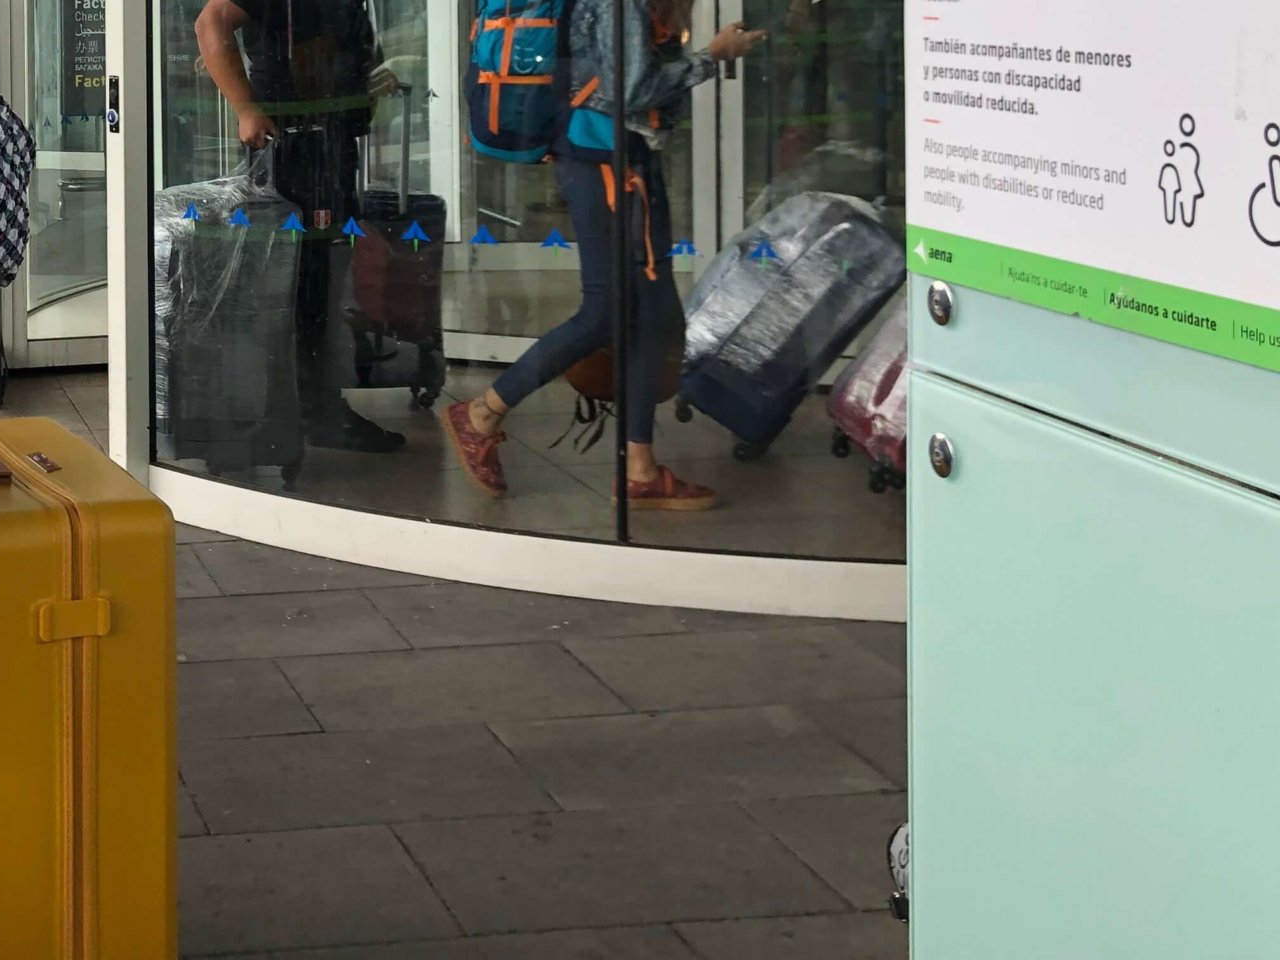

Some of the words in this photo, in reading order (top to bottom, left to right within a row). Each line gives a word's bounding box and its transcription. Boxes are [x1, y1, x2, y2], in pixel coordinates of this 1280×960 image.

[923, 36, 967, 56] También
[970, 42, 1052, 64] acompañantes
[1055, 46, 1071, 63] de
[1074, 51, 1132, 68] menores
[923, 66, 930, 80] y
[932, 66, 979, 82] personas
[982, 71, 1001, 85] con
[1004, 70, 1081, 92] discapacidad
[923, 90, 930, 102] o
[932, 90, 983, 109] movilidad
[986, 95, 1039, 115] reducida.
[923, 137, 944, 155] Also
[946, 141, 979, 162] people
[981, 148, 1058, 177] accompanying
[1060, 159, 1101, 181] minors
[1103, 167, 1127, 185] and
[923, 164, 956, 184] people
[958, 169, 980, 187] with
[982, 173, 1039, 198] disabilities
[1041, 186, 1054, 200] or
[1056, 187, 1104, 210] reduced
[923, 188, 965, 212] mobility.
[928, 247, 952, 263] aena
[1043, 278, 1048, 288] a
[1049, 278, 1088, 298] cuidar-te
[1109, 292, 1159, 316] Ayúdanos
[1162, 308, 1169, 319] a
[1171, 310, 1217, 331] cuidarte
[1240, 325, 1266, 346] Help
